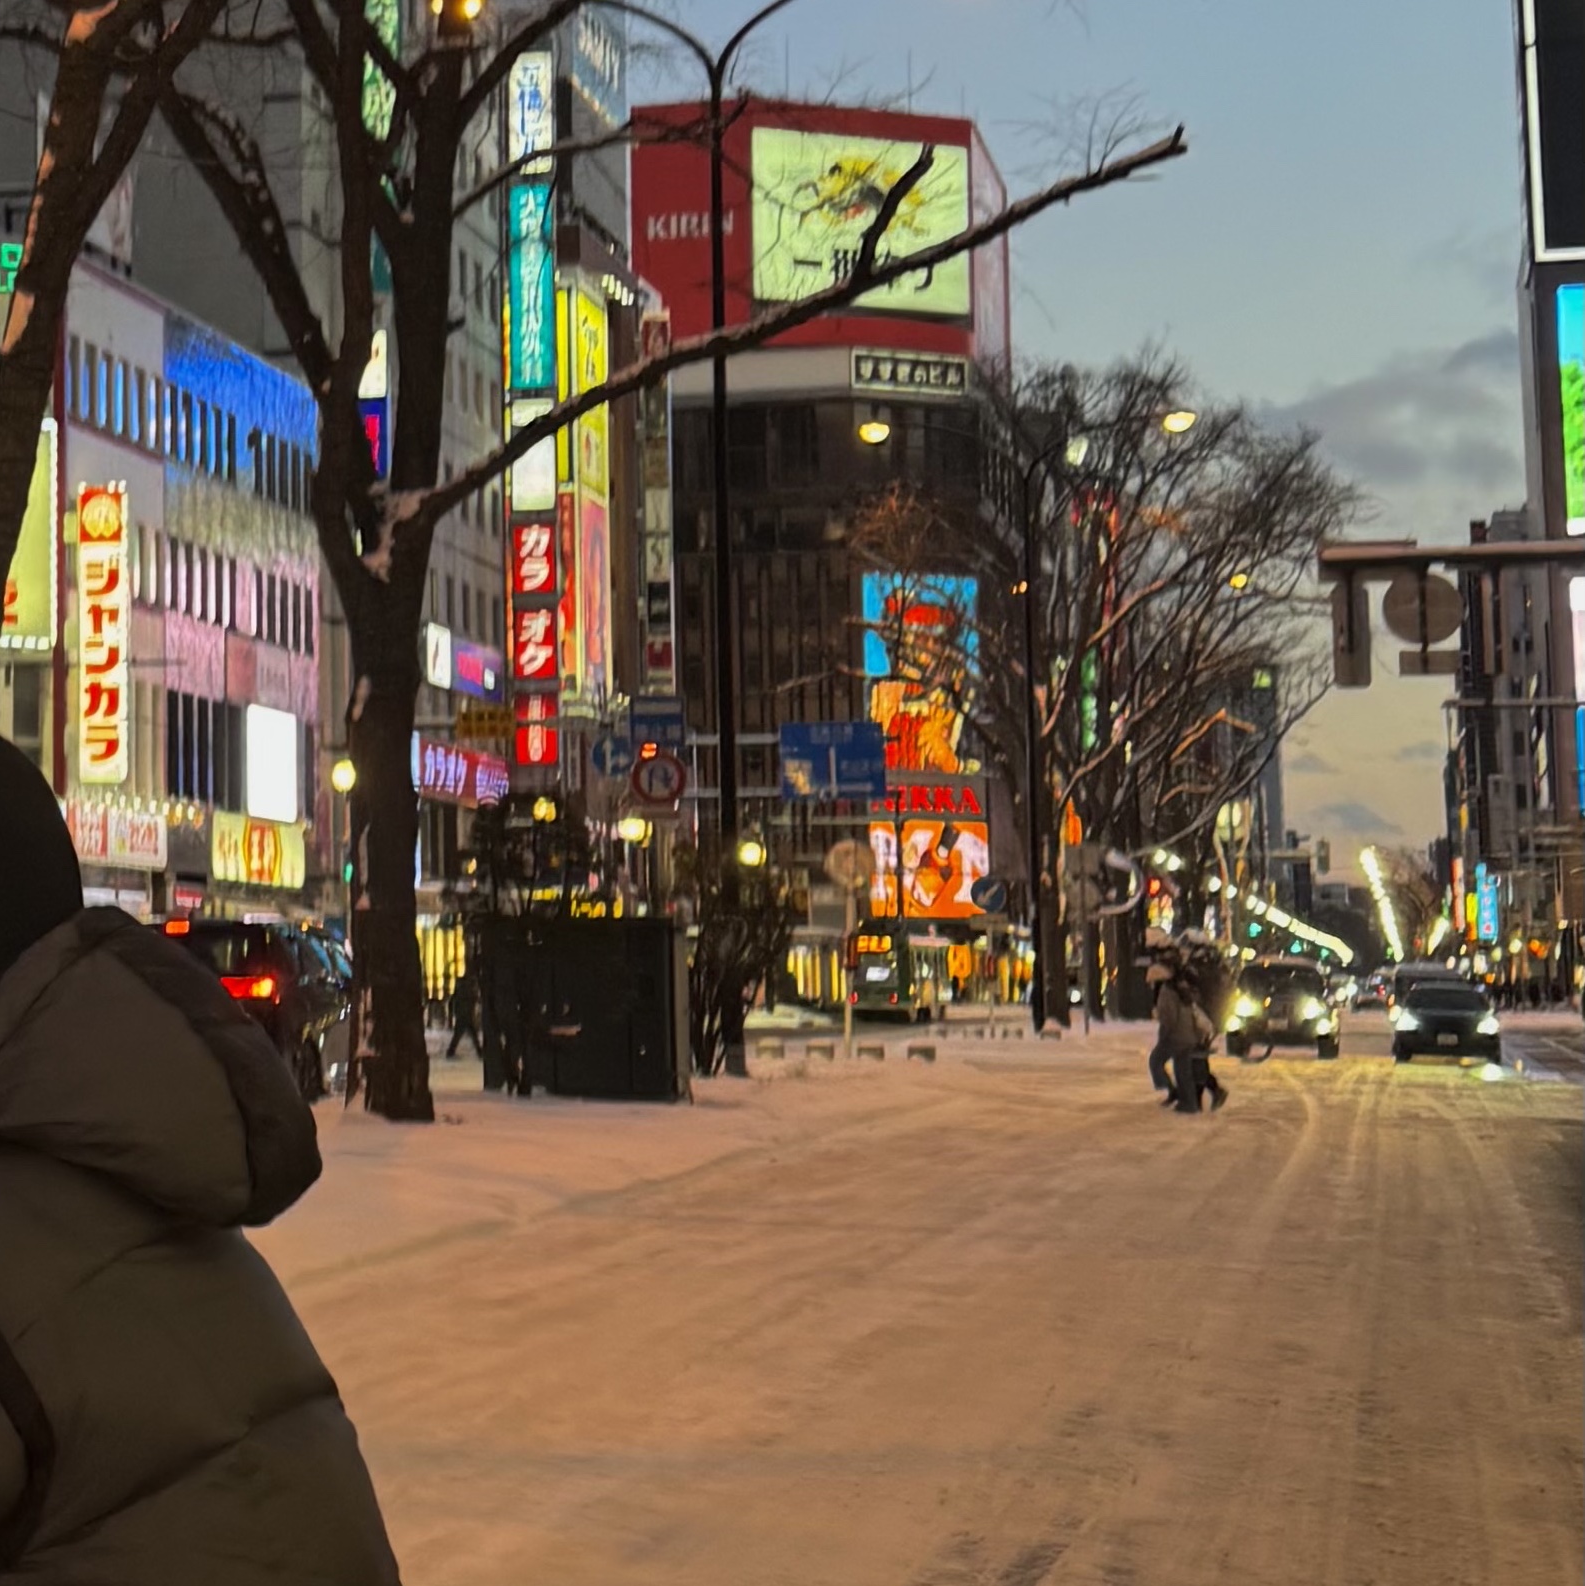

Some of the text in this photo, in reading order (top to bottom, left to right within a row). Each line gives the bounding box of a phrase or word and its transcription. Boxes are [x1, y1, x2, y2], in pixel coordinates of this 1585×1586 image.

[83, 554, 121, 763] ジャンカラ
